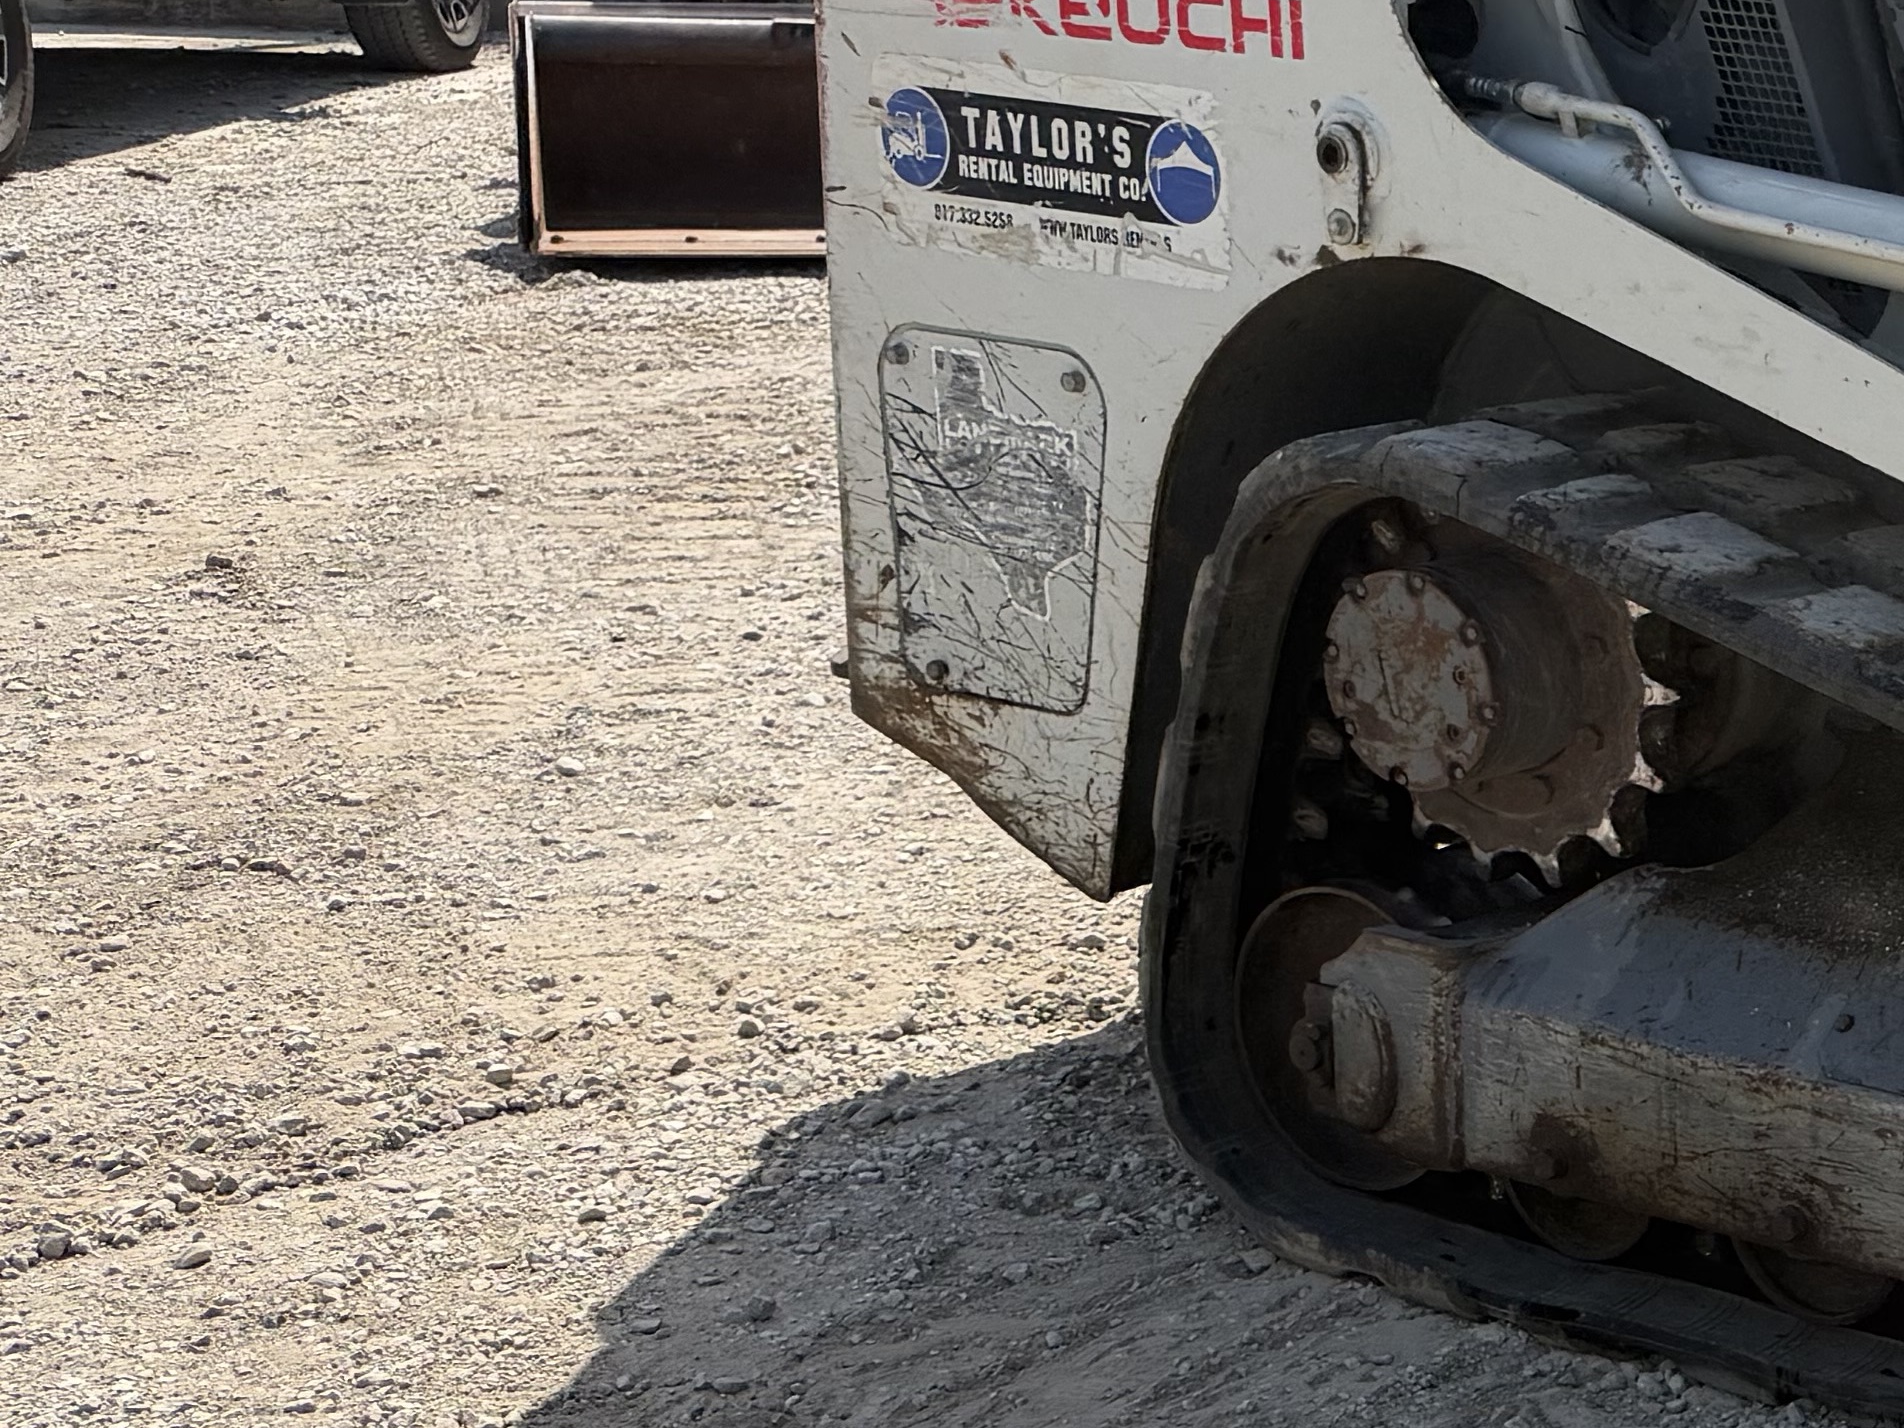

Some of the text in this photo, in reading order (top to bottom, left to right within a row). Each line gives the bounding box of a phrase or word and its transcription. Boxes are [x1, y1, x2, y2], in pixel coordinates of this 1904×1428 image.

[960, 106, 1132, 169] TAYLOR'S
[958, 154, 1018, 184] RENTAL
[1023, 162, 1113, 198] EQUIPMENT
